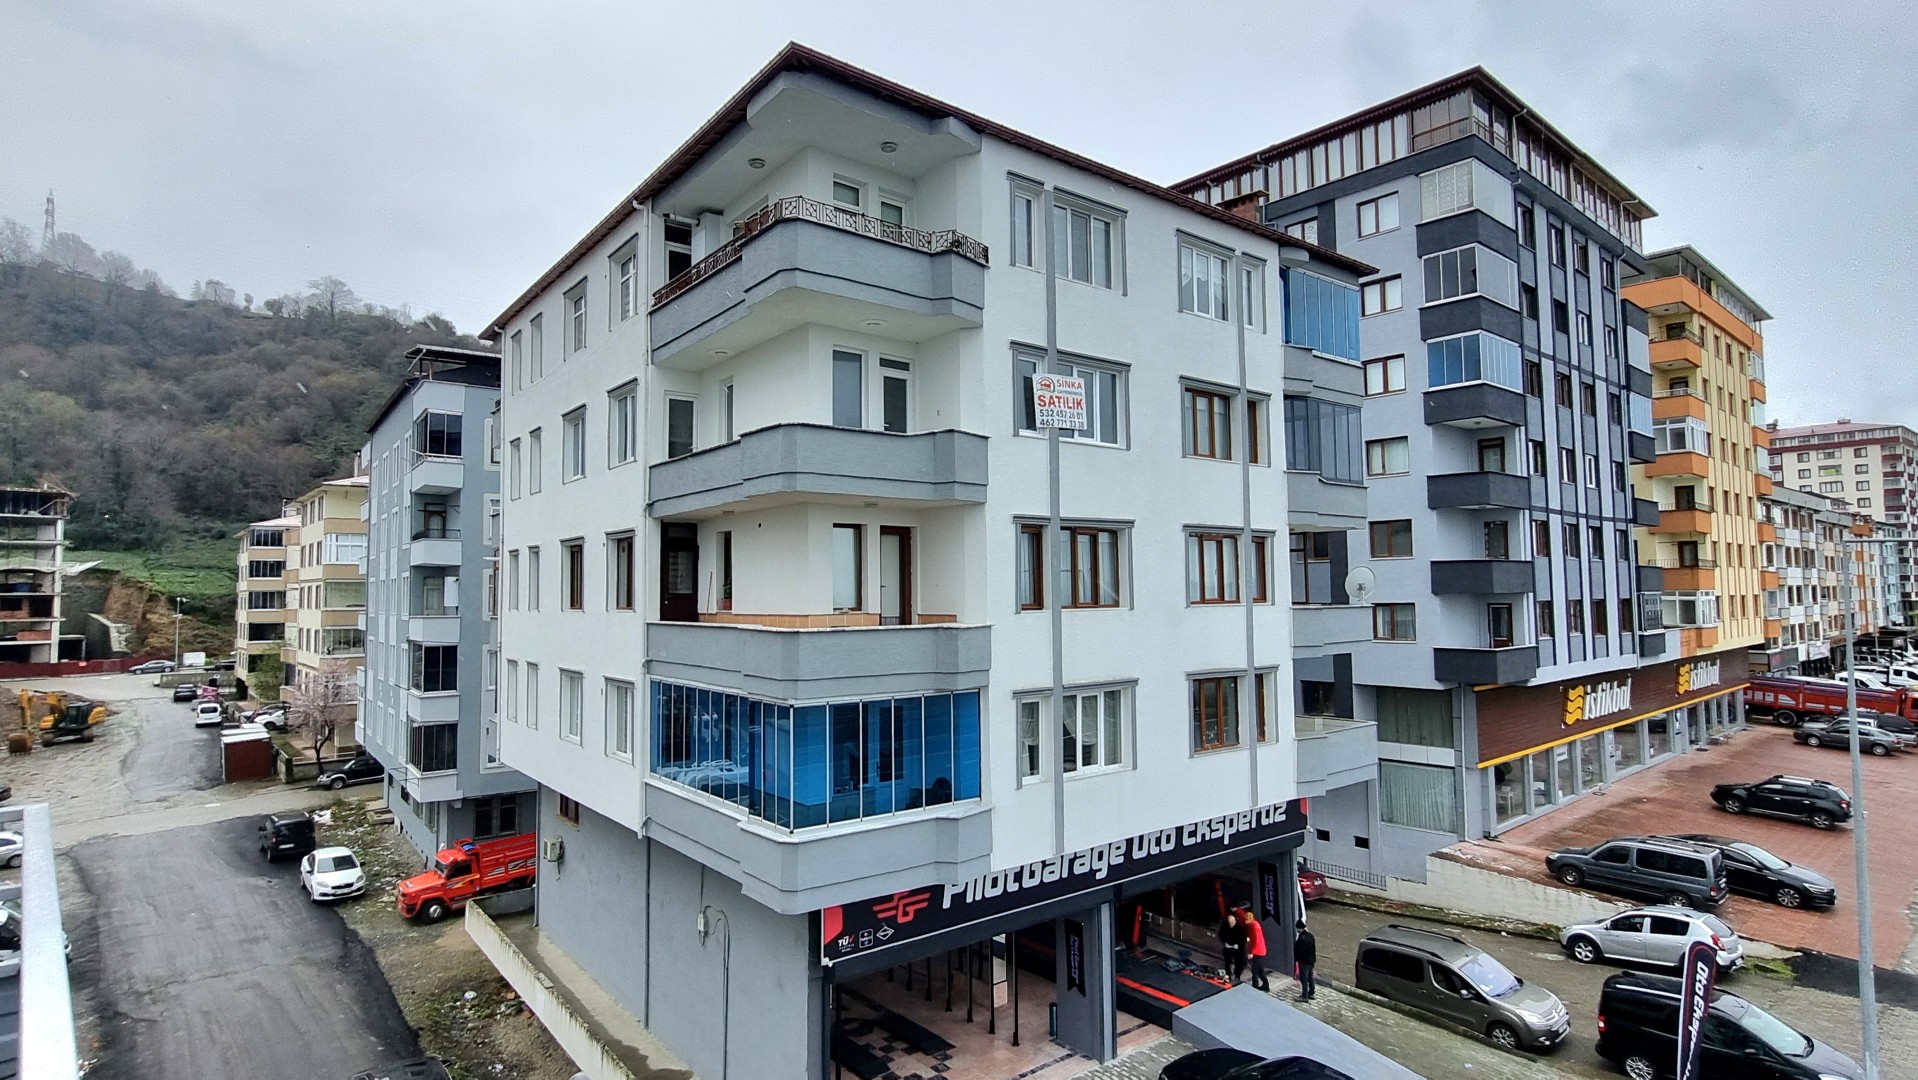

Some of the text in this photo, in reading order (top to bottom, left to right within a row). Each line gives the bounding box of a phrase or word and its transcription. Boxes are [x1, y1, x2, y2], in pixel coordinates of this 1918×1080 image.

[1056, 377, 1083, 391] SİNKA
[1037, 395, 1084, 410] SATILIK
[1039, 409, 1055, 418] 532
[1056, 410, 1068, 419] 457
[1077, 412, 1084, 421] 01
[1039, 418, 1055, 427] 462
[1069, 420, 1076, 428] 33
[1078, 421, 1085, 429] 38
[1689, 658, 1720, 691] istikbal
[1583, 676, 1632, 720] istikbal
[1695, 961, 1709, 996] Oto
